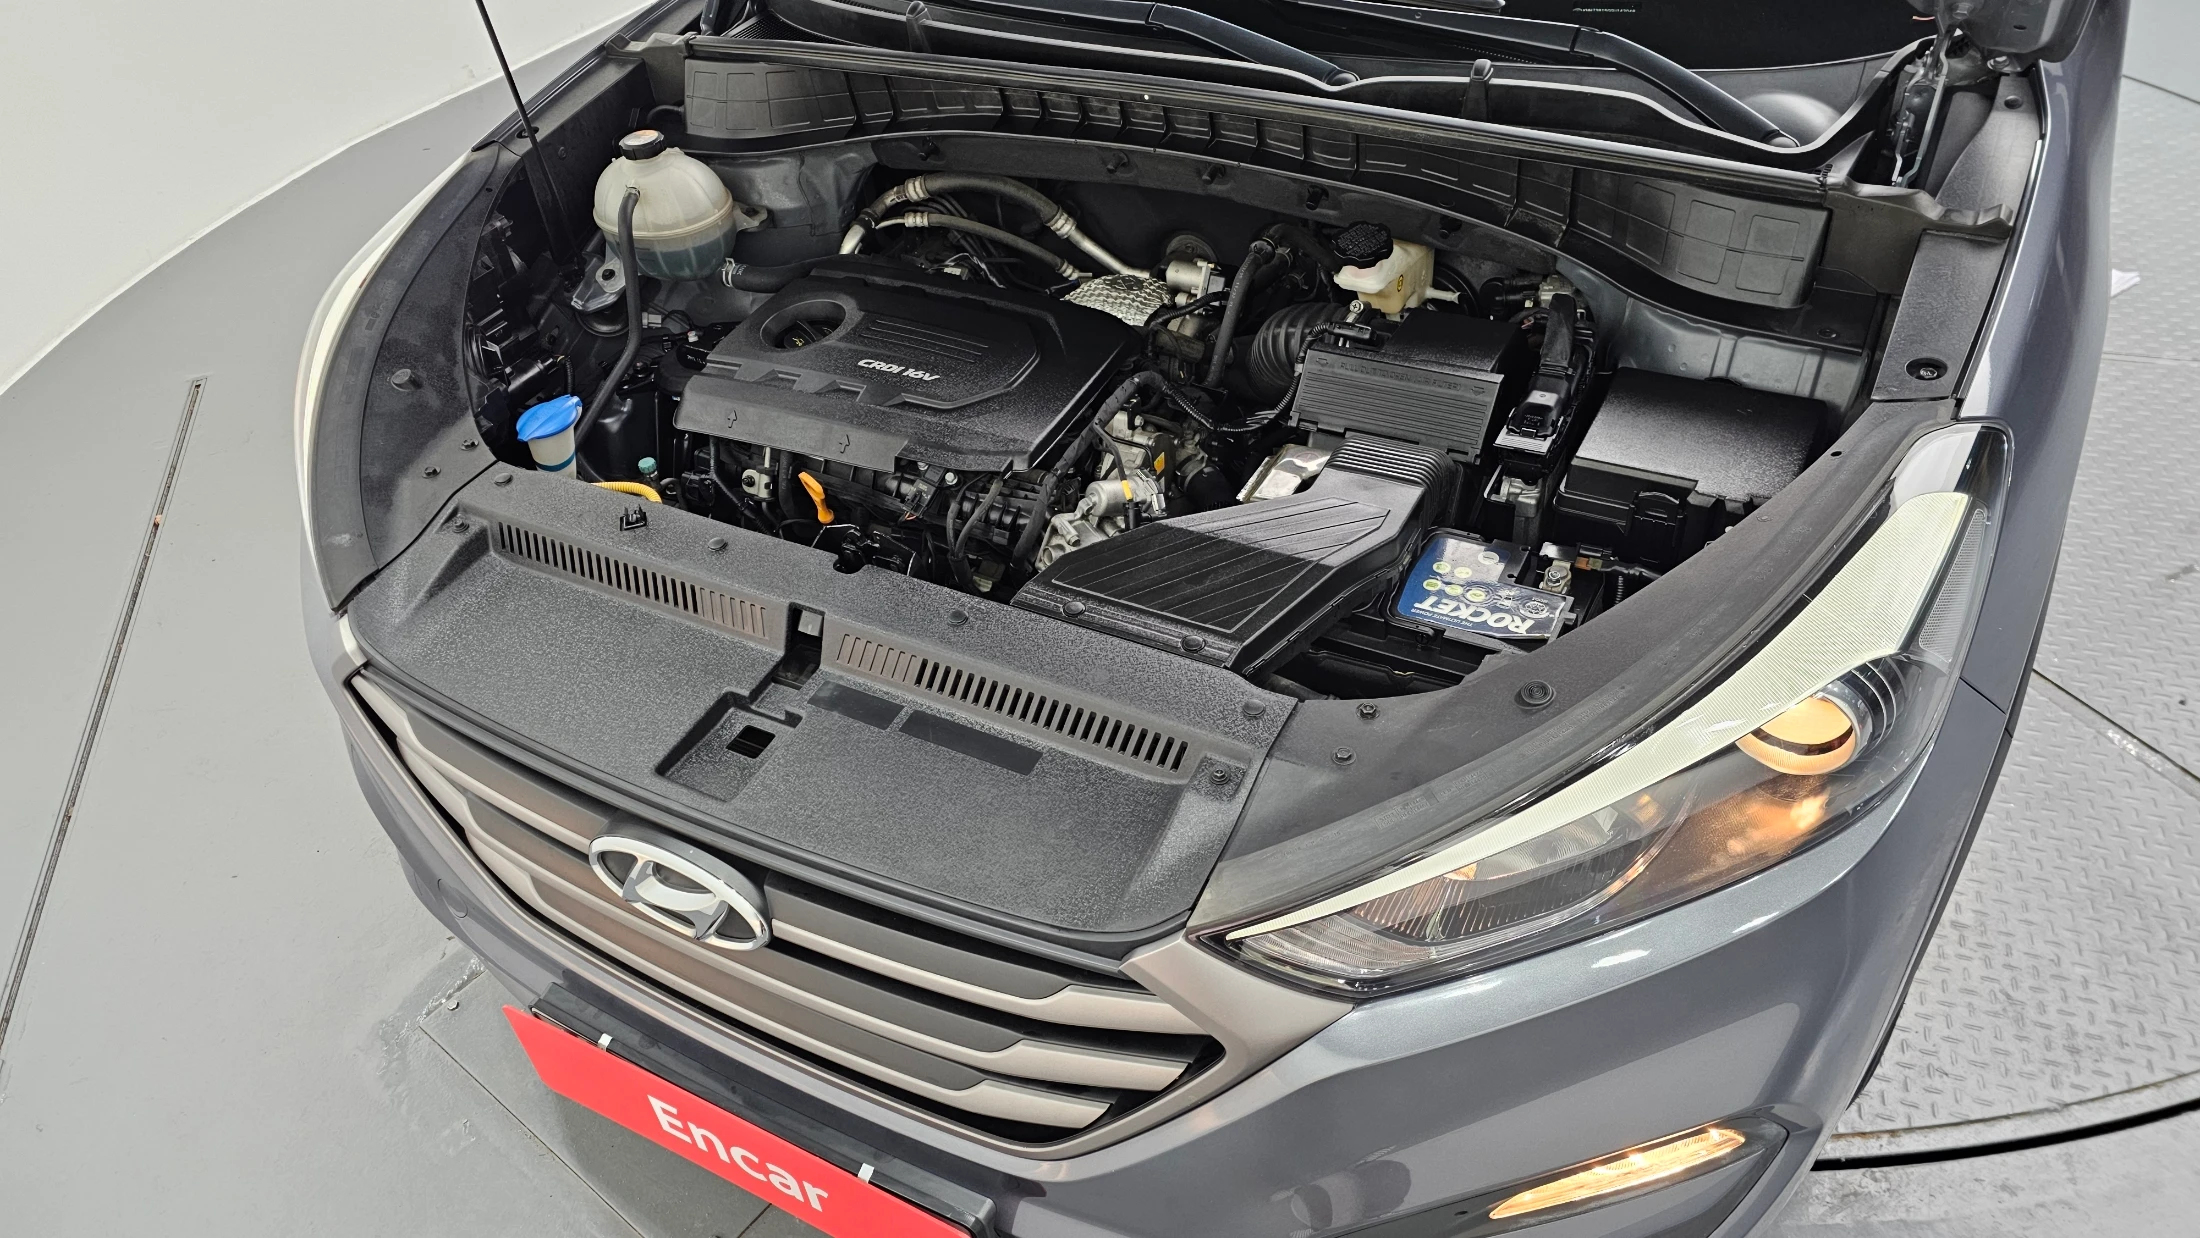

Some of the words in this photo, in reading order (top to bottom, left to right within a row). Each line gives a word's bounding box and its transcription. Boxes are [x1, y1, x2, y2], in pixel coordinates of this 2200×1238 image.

[858, 359, 906, 374] CRDI
[902, 368, 941, 381] 16V
[1410, 608, 1433, 617] POWER
[1413, 595, 1535, 635] ROCKET
[1432, 613, 1461, 624] ULTIMATE
[647, 1094, 829, 1212] Encar
